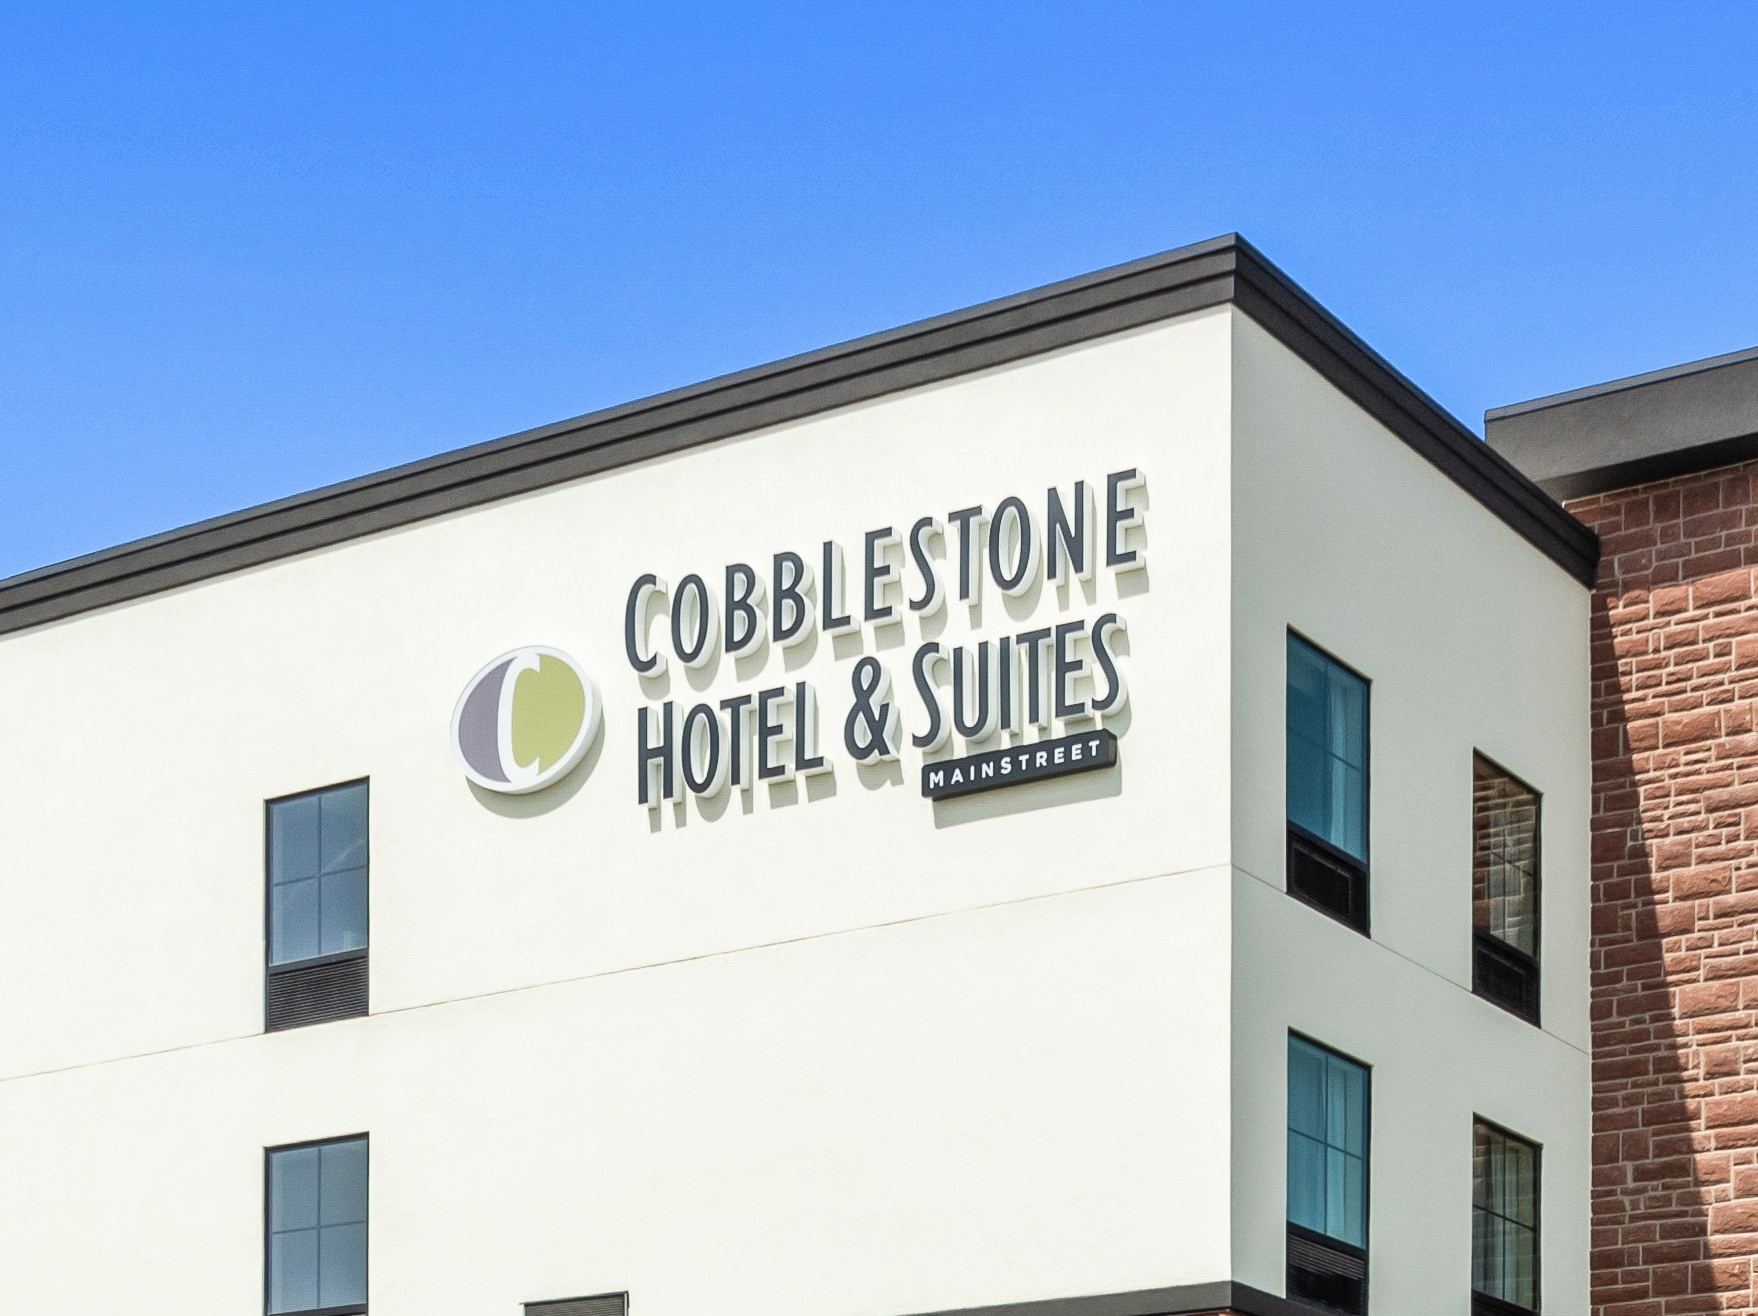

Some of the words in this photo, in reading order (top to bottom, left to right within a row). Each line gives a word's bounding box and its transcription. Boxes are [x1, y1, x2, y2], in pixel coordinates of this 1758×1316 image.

[625, 468, 1139, 673] COBBLESTONE
[638, 682, 824, 805] HOTEL
[844, 656, 891, 761] &
[912, 613, 1119, 748] SUITES
[929, 740, 1100, 789] MAINSTREET
